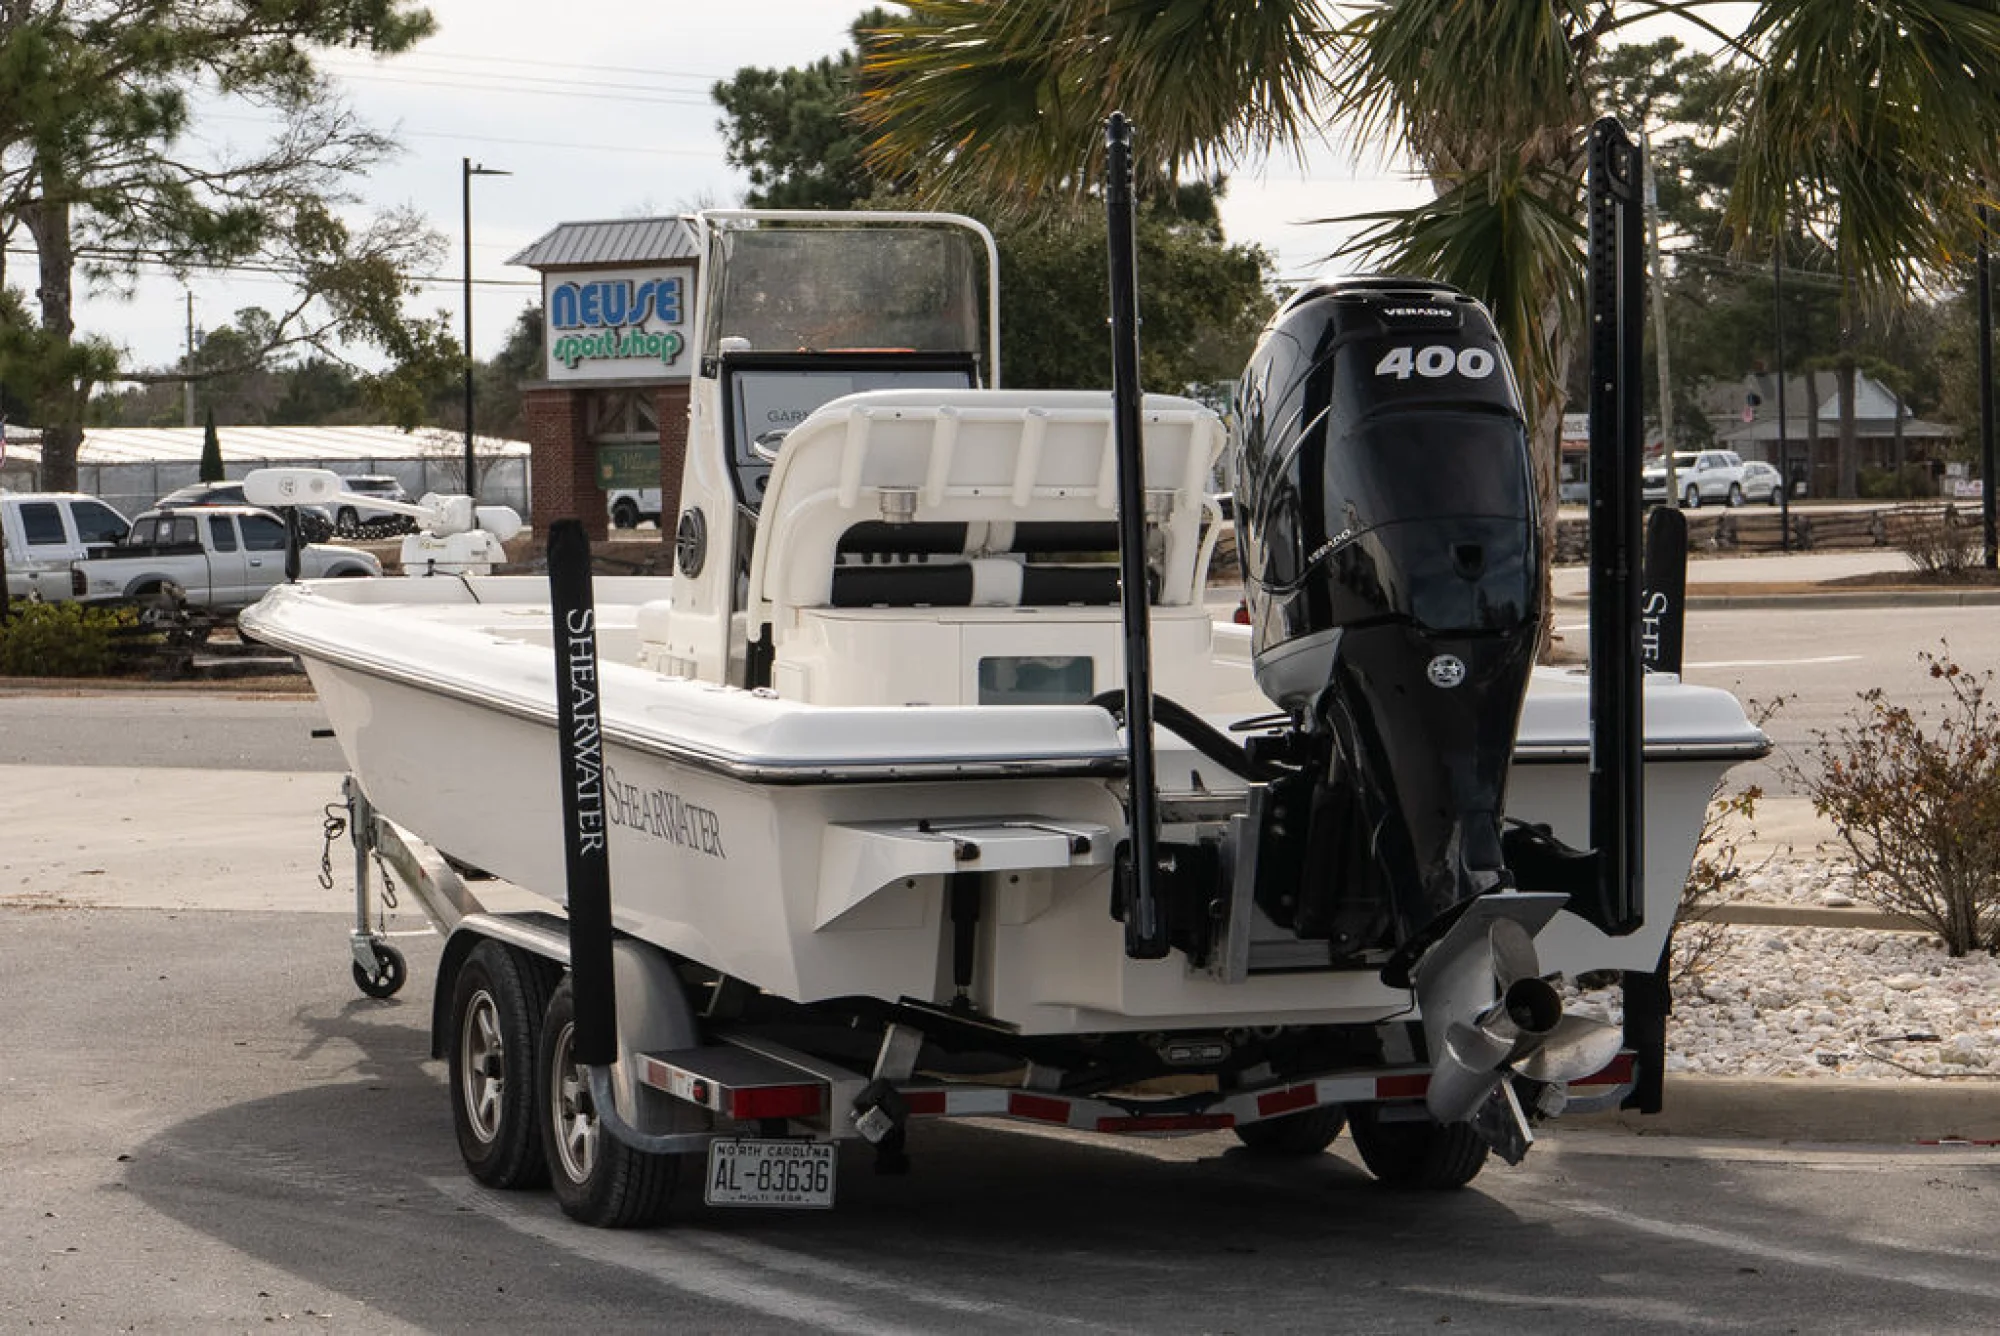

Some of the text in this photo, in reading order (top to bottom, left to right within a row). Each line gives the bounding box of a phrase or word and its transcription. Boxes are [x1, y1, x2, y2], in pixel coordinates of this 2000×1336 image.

[552, 279, 680, 328] NEUSE
[1383, 307, 1452, 318] VERADO
[553, 328, 679, 367] sport shop
[1374, 345, 1495, 380] 400
[566, 608, 604, 856] SHEARWATER
[605, 765, 727, 860] SHEARWATER
[717, 1145, 831, 1158] NORTH CAROLINA
[714, 1157, 830, 1193] AL-83636
